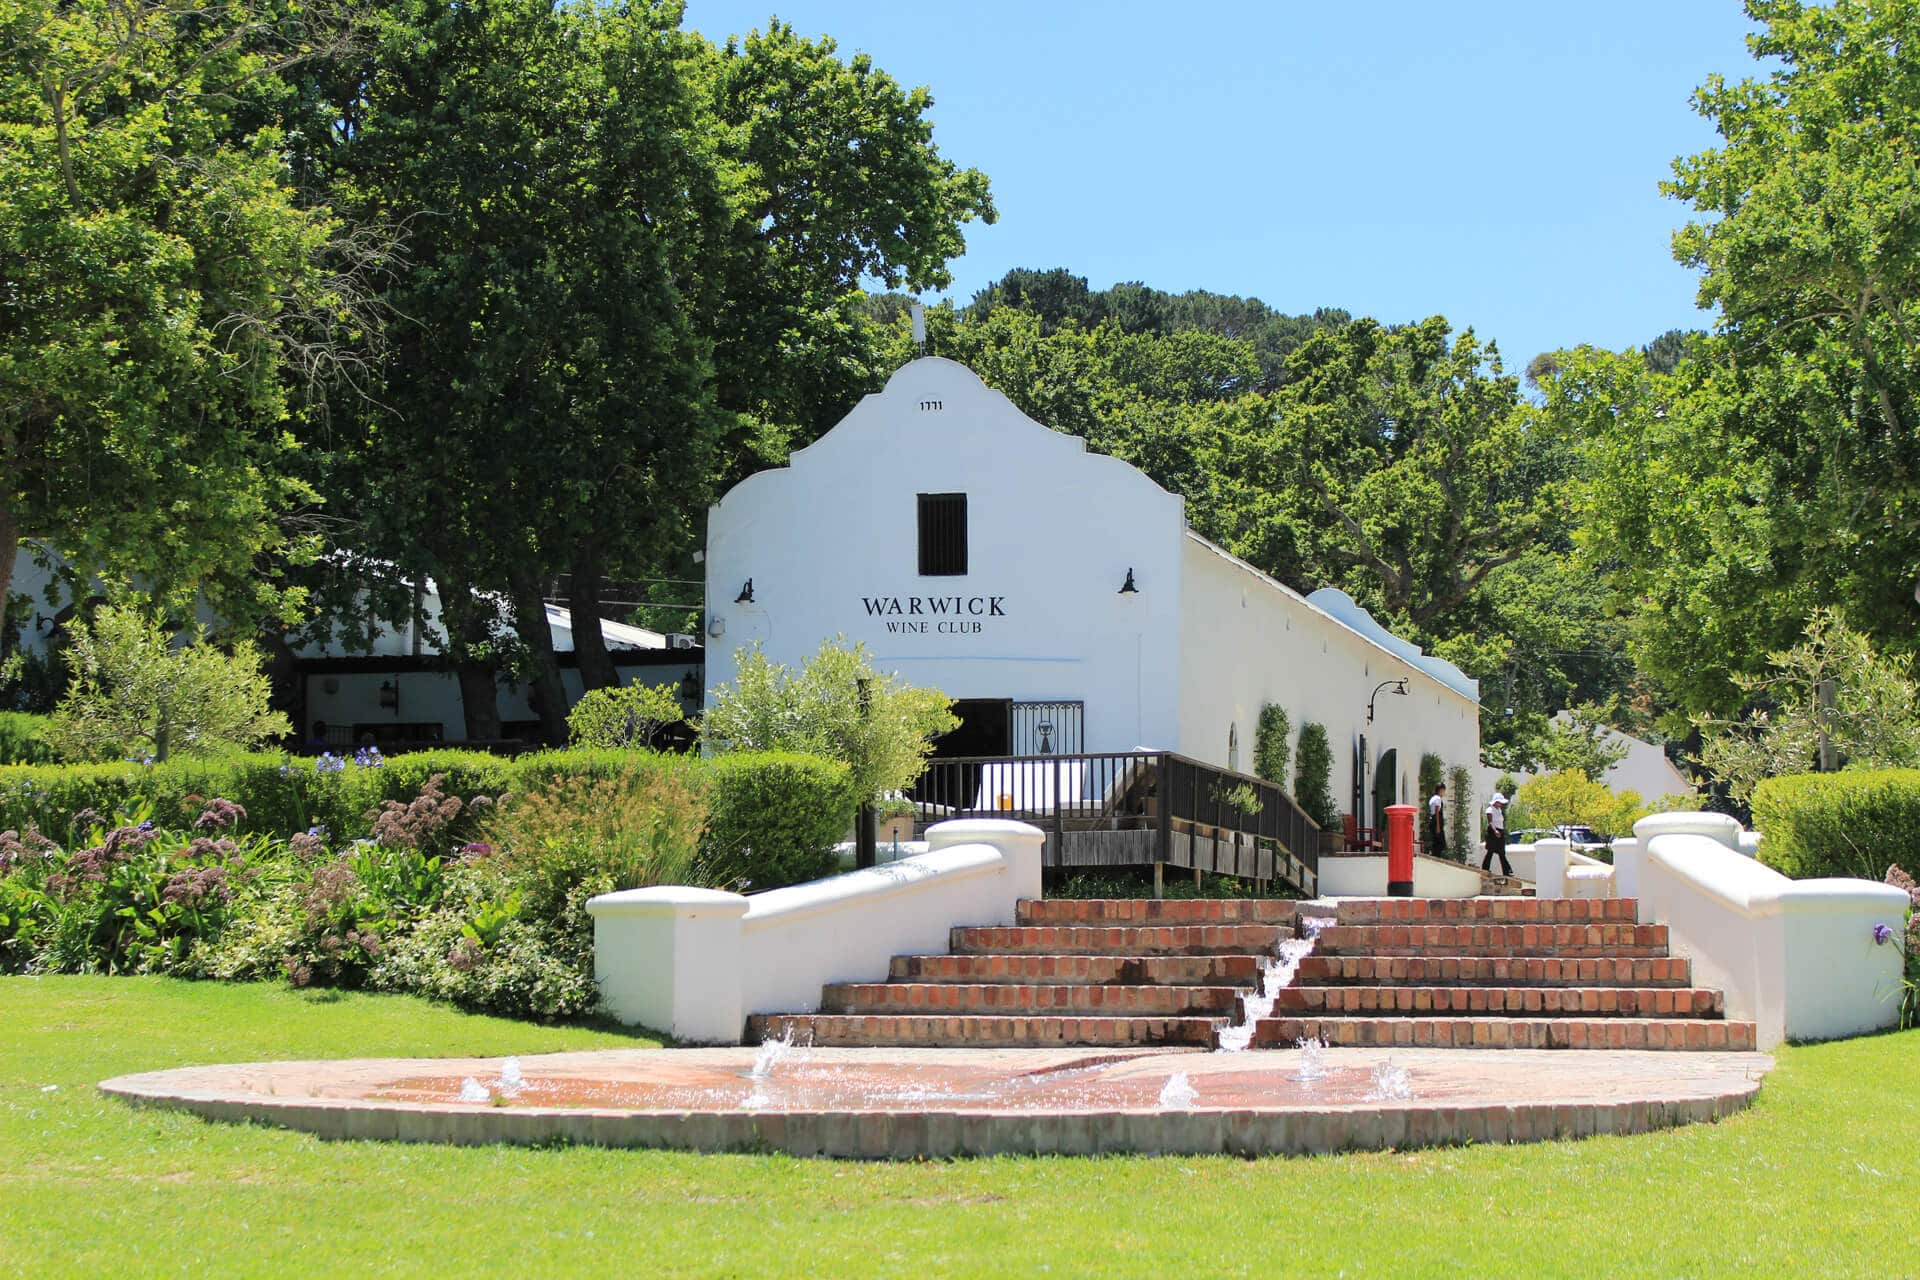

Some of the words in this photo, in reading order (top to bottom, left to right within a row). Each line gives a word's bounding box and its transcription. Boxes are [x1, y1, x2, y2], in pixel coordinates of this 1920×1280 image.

[861, 596, 1007, 617] WARWICK
[886, 621, 929, 634] WINE
[937, 621, 983, 634] CLUB
